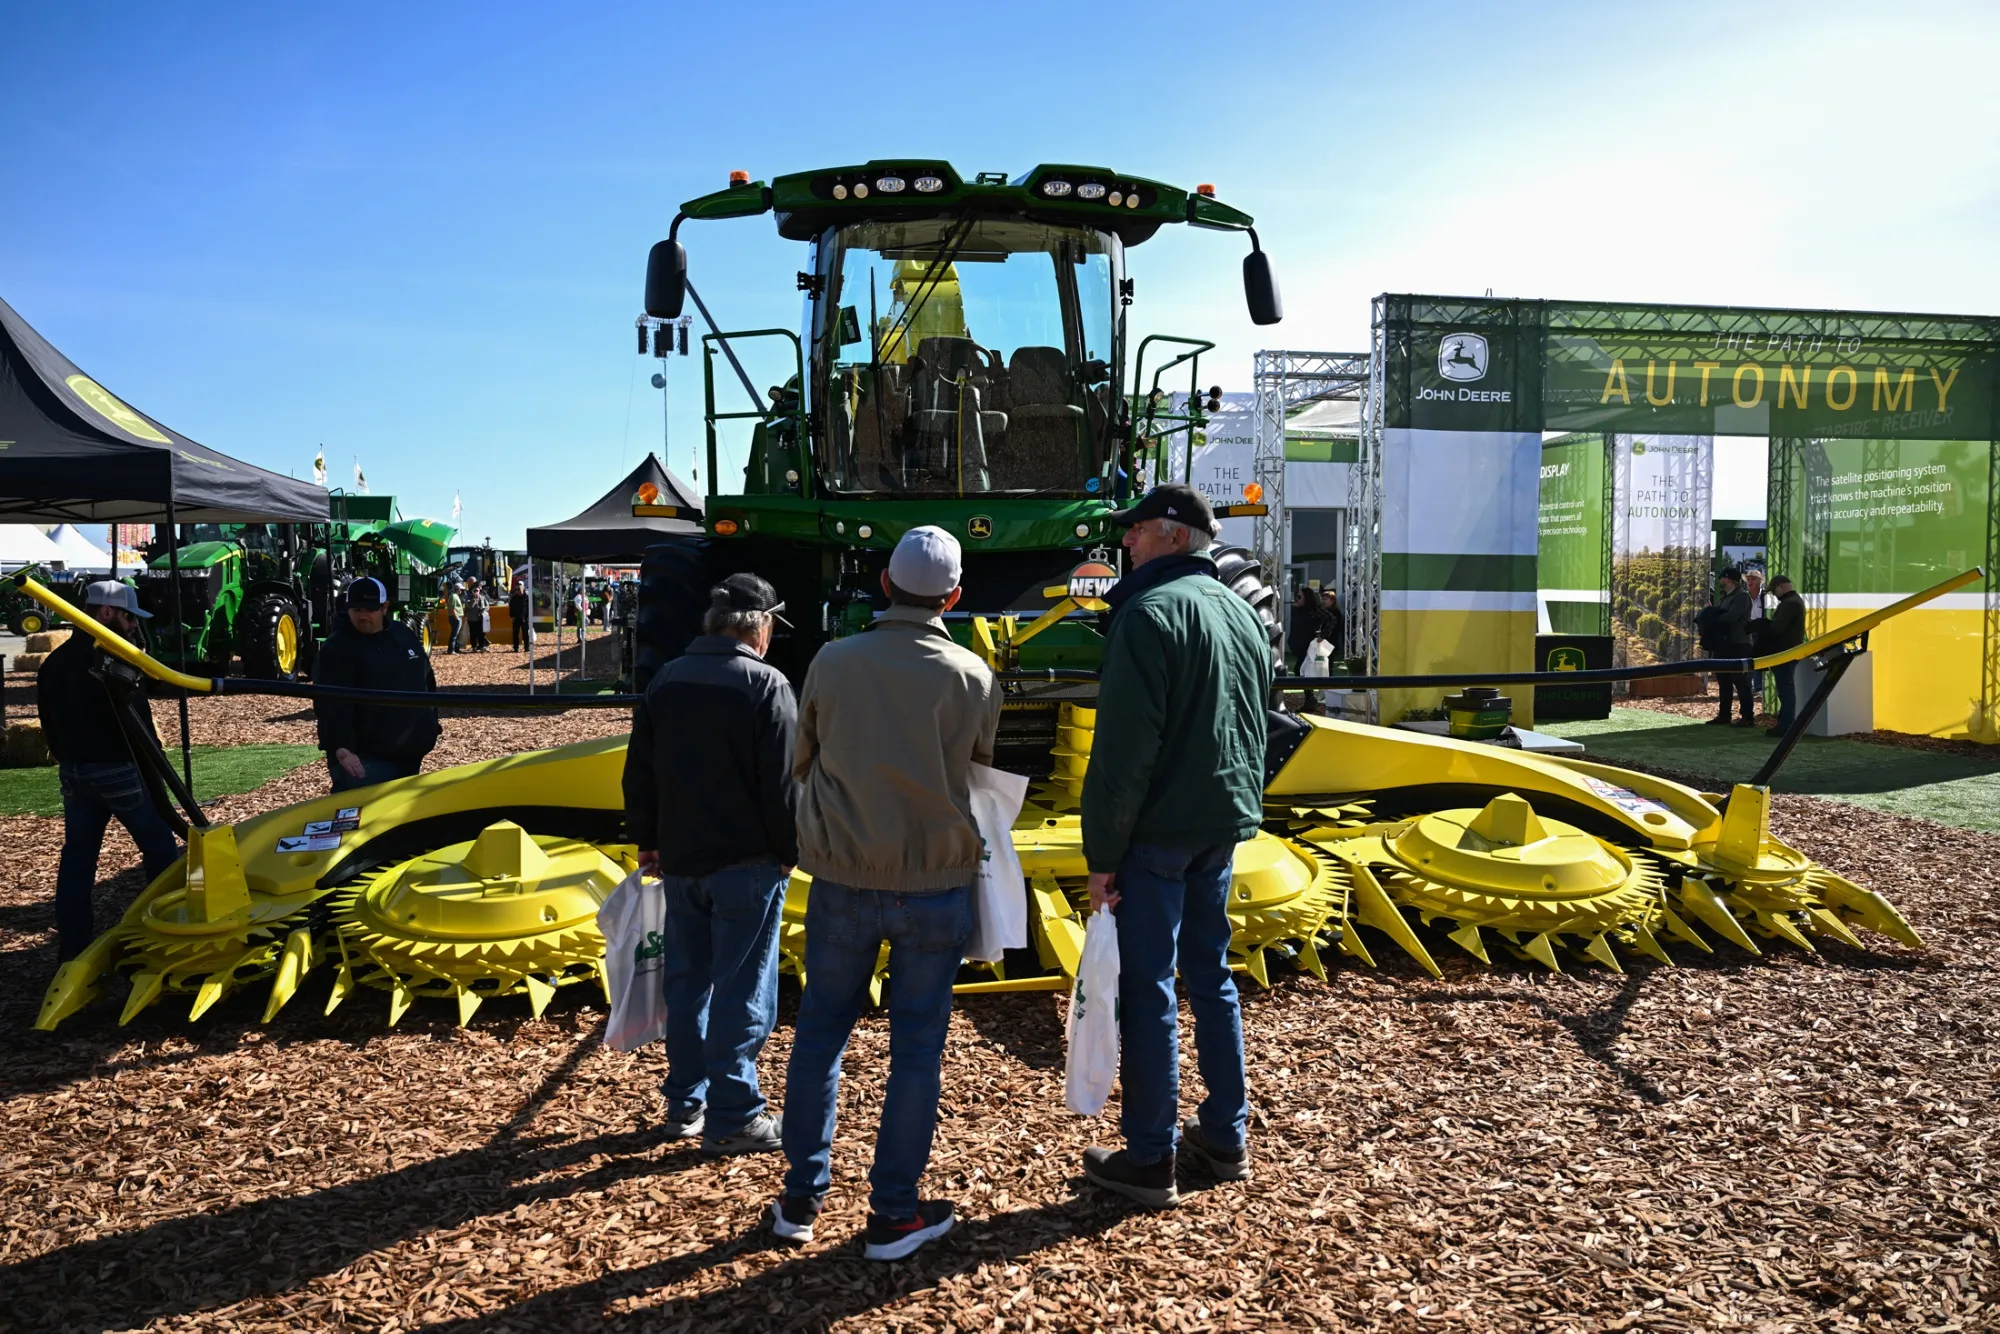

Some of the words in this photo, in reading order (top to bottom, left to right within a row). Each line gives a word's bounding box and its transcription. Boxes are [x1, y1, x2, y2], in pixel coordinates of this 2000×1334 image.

[1714, 332, 1756, 350] THE
[1767, 334, 1824, 353] PATH
[1836, 337, 1861, 354] TO
[1600, 358, 1960, 412] AUTONOMY
[1415, 386, 1455, 400] JOHN
[1458, 388, 1511, 402] DEERE
[1882, 406, 1954, 433] RECEIVER
[1210, 436, 1234, 444] JOHN
[1235, 436, 1253, 444] DEE
[1648, 445, 1670, 453] JOHN
[1672, 446, 1699, 454] DEERE
[1214, 467, 1240, 479] THE
[1540, 462, 1569, 479] DISPLAY
[1816, 475, 1830, 487] The
[1831, 471, 1863, 486] satellite
[1864, 467, 1912, 484] positioning
[1914, 463, 1946, 479] system
[1652, 475, 1675, 487] THE
[1198, 483, 1232, 495] PATH
[1810, 493, 1827, 505] that
[1829, 491, 1854, 503] knows
[1855, 489, 1868, 501] the
[1870, 484, 1912, 499] machine's
[1914, 481, 1952, 498] position
[1637, 490, 1667, 502] PATH
[1674, 491, 1689, 502] TO
[1628, 506, 1698, 518] AUTONOMY
[1815, 509, 1832, 521] with
[1833, 507, 1868, 521] accuracy
[1870, 504, 1886, 517] and
[1887, 500, 1945, 517] repeatability.
[1735, 532, 1765, 543] REA
[1535, 690, 1561, 700] OHN
